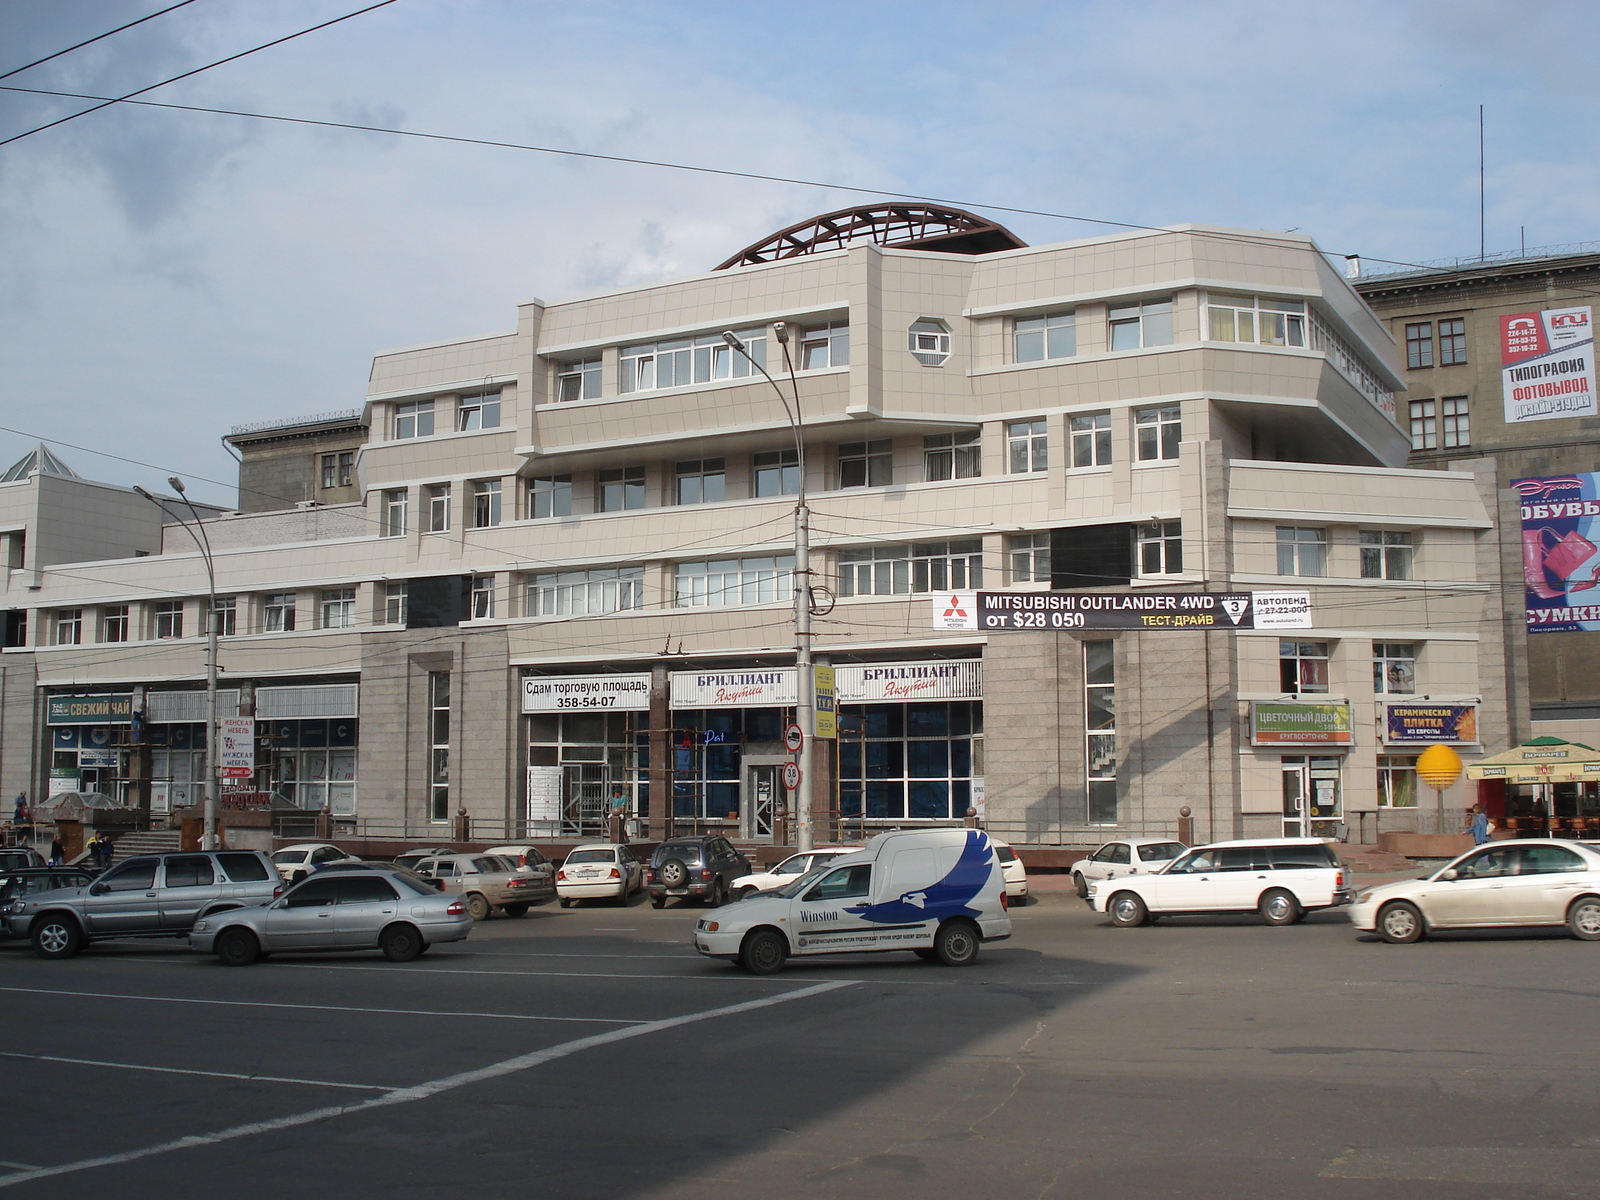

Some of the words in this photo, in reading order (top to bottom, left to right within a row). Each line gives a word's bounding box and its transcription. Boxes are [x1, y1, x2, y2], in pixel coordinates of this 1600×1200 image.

[1508, 357, 1585, 383] ТИПОГРАФИЯ
[1512, 377, 1589, 402] ФОТОВЫВОД
[1515, 395, 1591, 420] ДИЗАЙН-СТУДИЯ
[1521, 501, 1600, 520] ОБУВЬ
[985, 596, 1075, 610] MITSUBISHI
[1080, 596, 1177, 610] OUTLANDER
[1180, 596, 1214, 609] 4WD
[1231, 601, 1240, 612] 3
[1257, 597, 1307, 605] АВТОЛЕНД
[986, 615, 1008, 627] от
[1013, 611, 1046, 628] $28
[1052, 612, 1085, 628] 050
[1141, 613, 1214, 626] ТЕСТ-ДРАЙВ
[697, 673, 783, 687] БРИЛЛИАНТ
[864, 665, 959, 681] БРИЛЛИАНТ
[526, 682, 551, 696] Сдам
[554, 682, 600, 695] торговую
[603, 681, 648, 694] площадь
[714, 686, 763, 703] Якутии
[816, 686, 833, 696] ГАЗЕТА
[883, 679, 937, 697] Якутии
[70, 700, 109, 716] СВЕЖИЙ
[111, 700, 129, 715] ЧАЙ
[557, 697, 616, 708] 358-54-07
[1260, 712, 1313, 724] ЦВЕТОЧНЫЙ
[1315, 712, 1339, 724] ДВОР
[1394, 709, 1451, 717] КЕРАМИЧЕСКАЯ
[1403, 718, 1444, 728] ПЛИТКА
[1524, 751, 1566, 759] БОЧКАРЕВ
[800, 910, 838, 923] Winston
